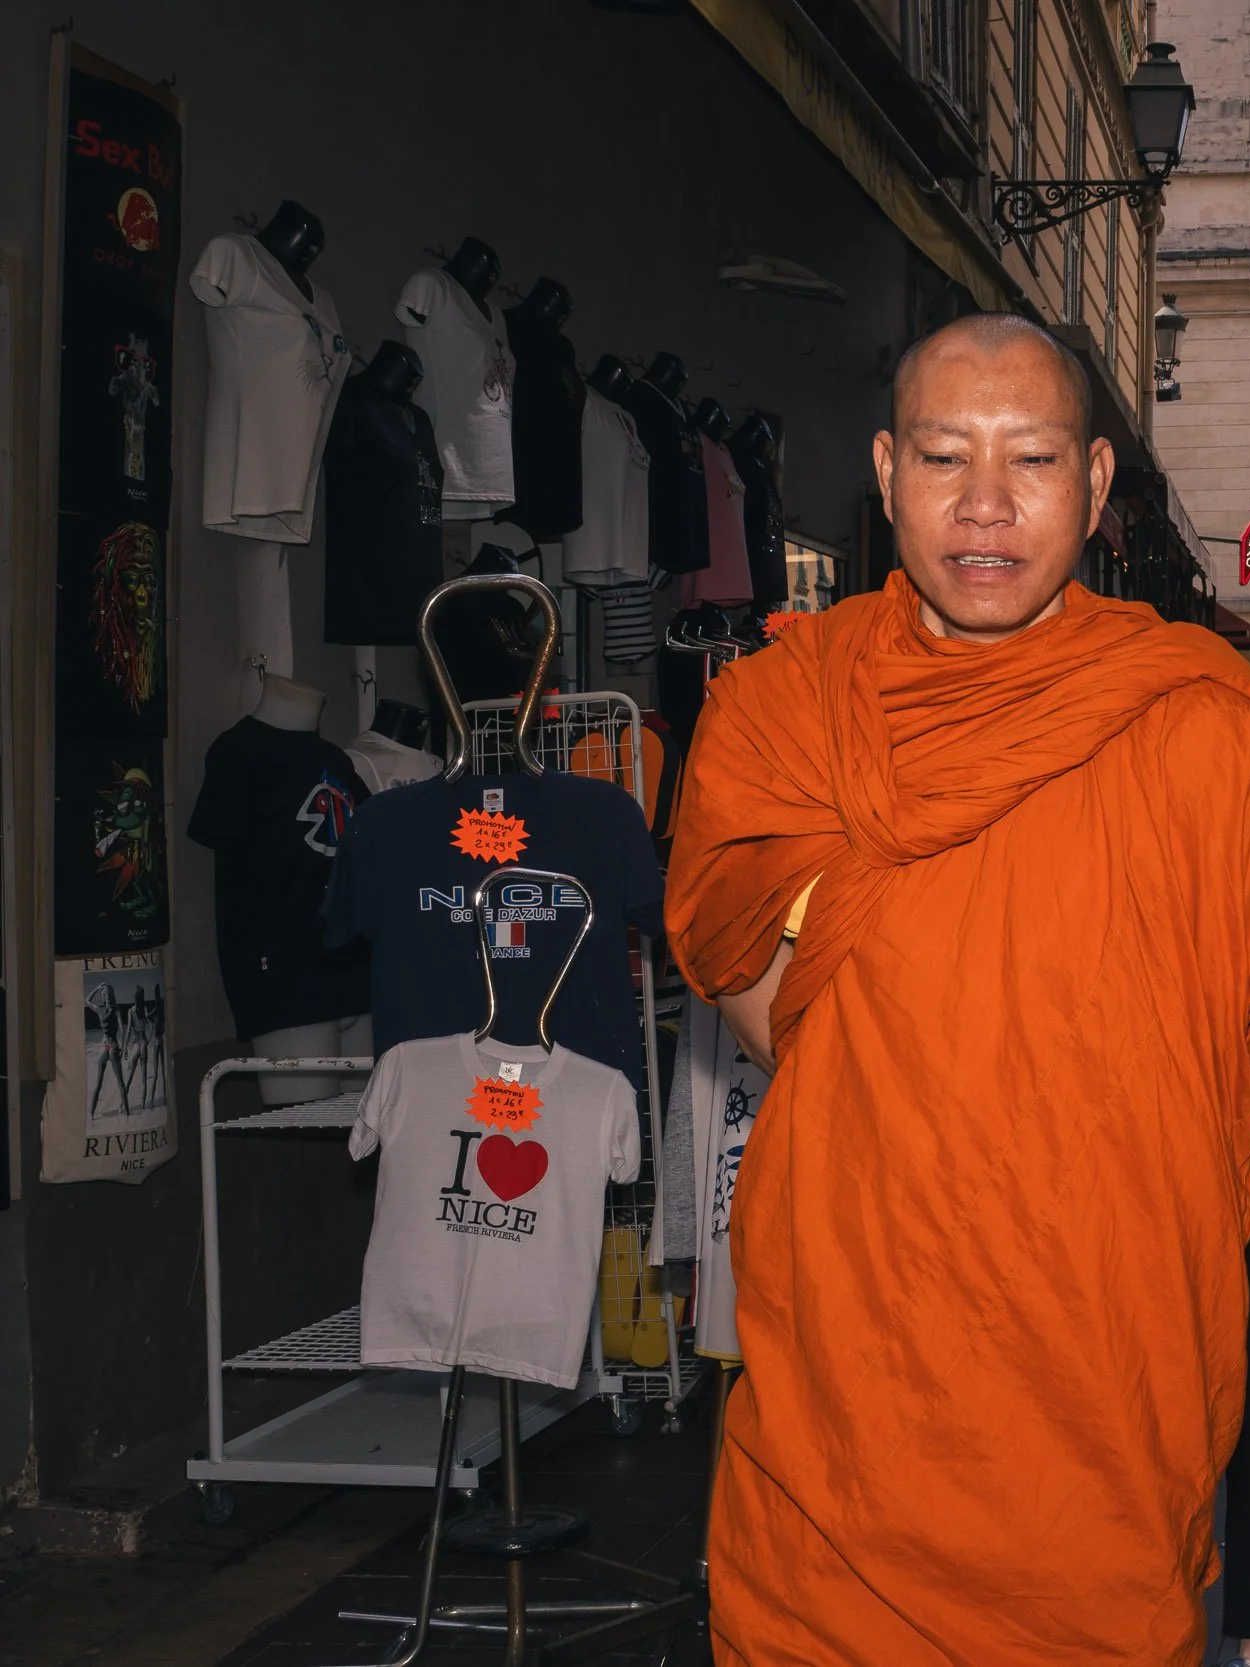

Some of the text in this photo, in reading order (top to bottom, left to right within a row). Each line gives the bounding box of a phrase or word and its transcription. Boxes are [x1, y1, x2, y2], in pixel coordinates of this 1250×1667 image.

[76, 120, 142, 173] Sex
[492, 830, 501, 839] 16
[475, 839, 483, 848] 2
[451, 908, 557, 923] COE D'AZUR
[127, 929, 149, 937] Nice
[491, 1108, 498, 1117] 2
[83, 1127, 169, 1158] RIVIERA
[121, 1158, 146, 1171] NICE
[440, 1129, 483, 1197] I
[435, 1196, 538, 1236] NICE
[446, 1222, 522, 1243] FRENCH RIVIERA
